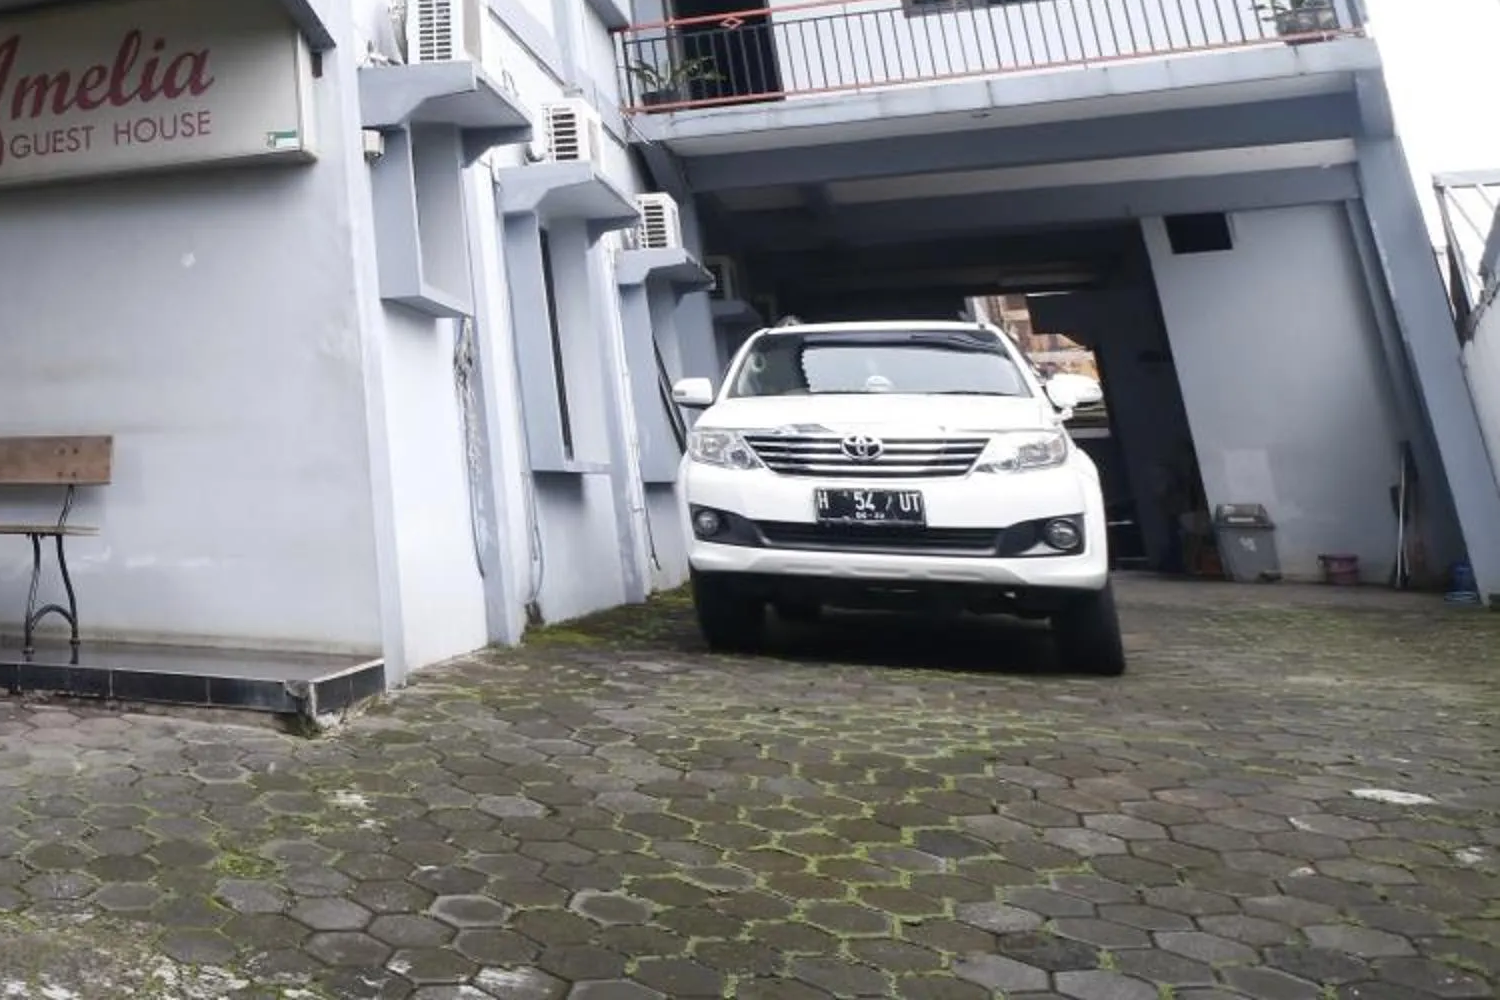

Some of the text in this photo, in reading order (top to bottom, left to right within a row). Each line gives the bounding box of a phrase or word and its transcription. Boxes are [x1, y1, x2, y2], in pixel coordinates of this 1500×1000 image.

[9, 110, 211, 159] GUEST HOUSE
[899, 492, 920, 513] UT
